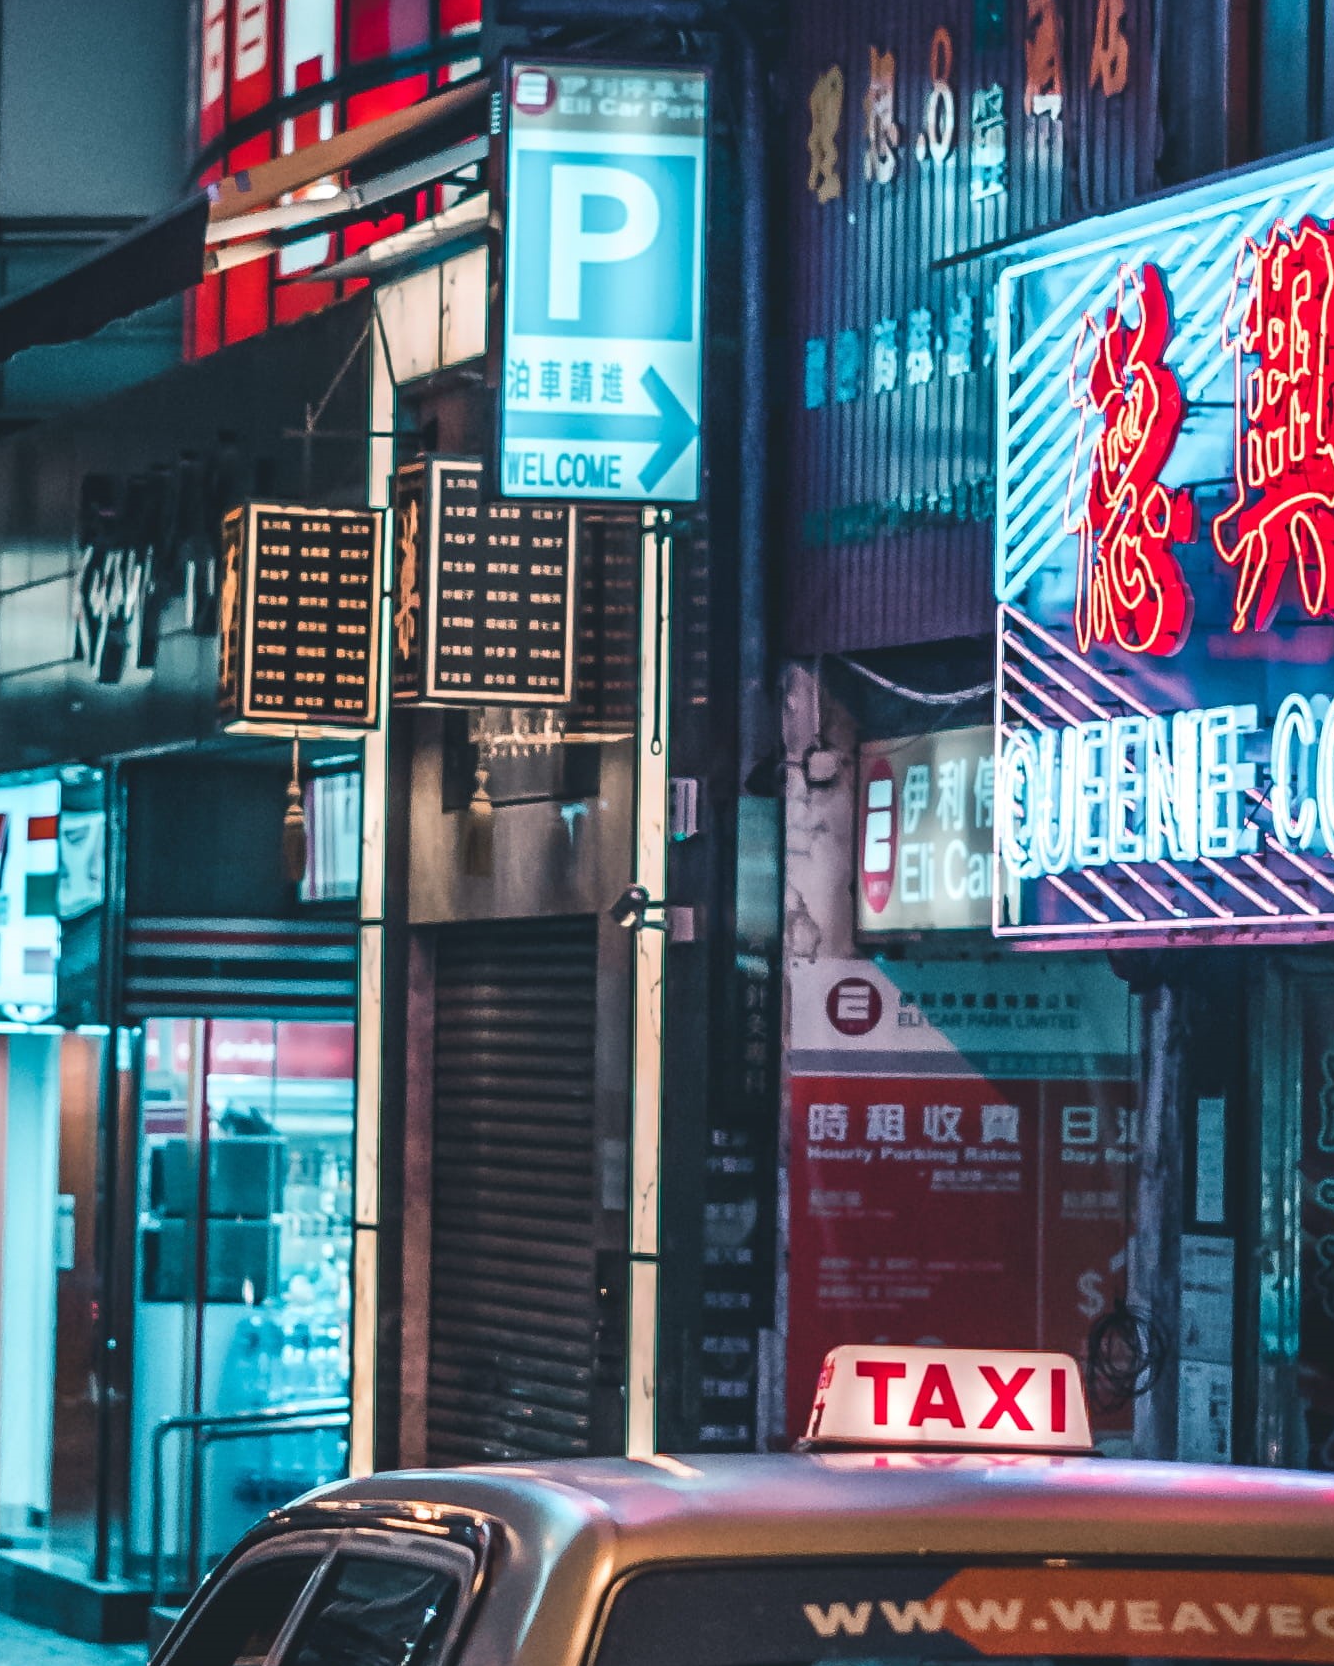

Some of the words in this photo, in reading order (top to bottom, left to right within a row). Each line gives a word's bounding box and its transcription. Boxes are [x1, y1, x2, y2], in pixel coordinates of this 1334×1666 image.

[598, 100, 642, 118] Car
[548, 164, 660, 322] P
[508, 359, 624, 403] 泊車請進
[504, 452, 623, 490] WELCOME
[901, 755, 995, 834] 伊利停
[900, 844, 934, 905] Eli
[807, 1102, 1020, 1143] 時租收費
[856, 1361, 1067, 1433] TAXI
